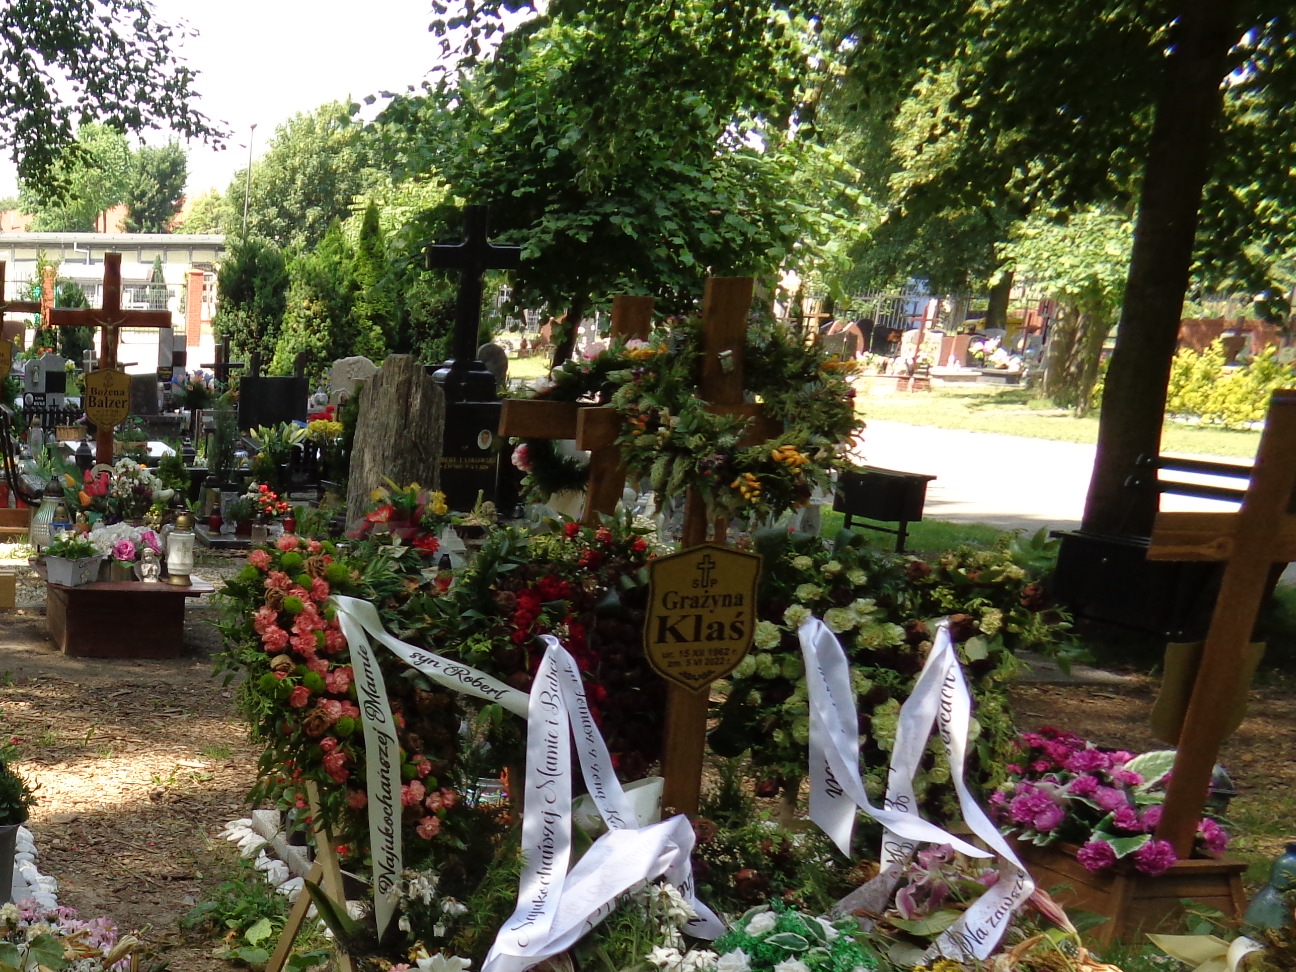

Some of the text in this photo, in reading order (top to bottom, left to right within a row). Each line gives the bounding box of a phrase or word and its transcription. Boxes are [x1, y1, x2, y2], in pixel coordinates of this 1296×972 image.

[88, 396, 128, 408] Balzer
[662, 589, 744, 614] Grażyna
[654, 611, 746, 644] Klaś
[409, 652, 511, 701] syn Robert
[360, 644, 400, 896] Najukochańszej Mamie
[510, 809, 562, 948] Najukochańszej
